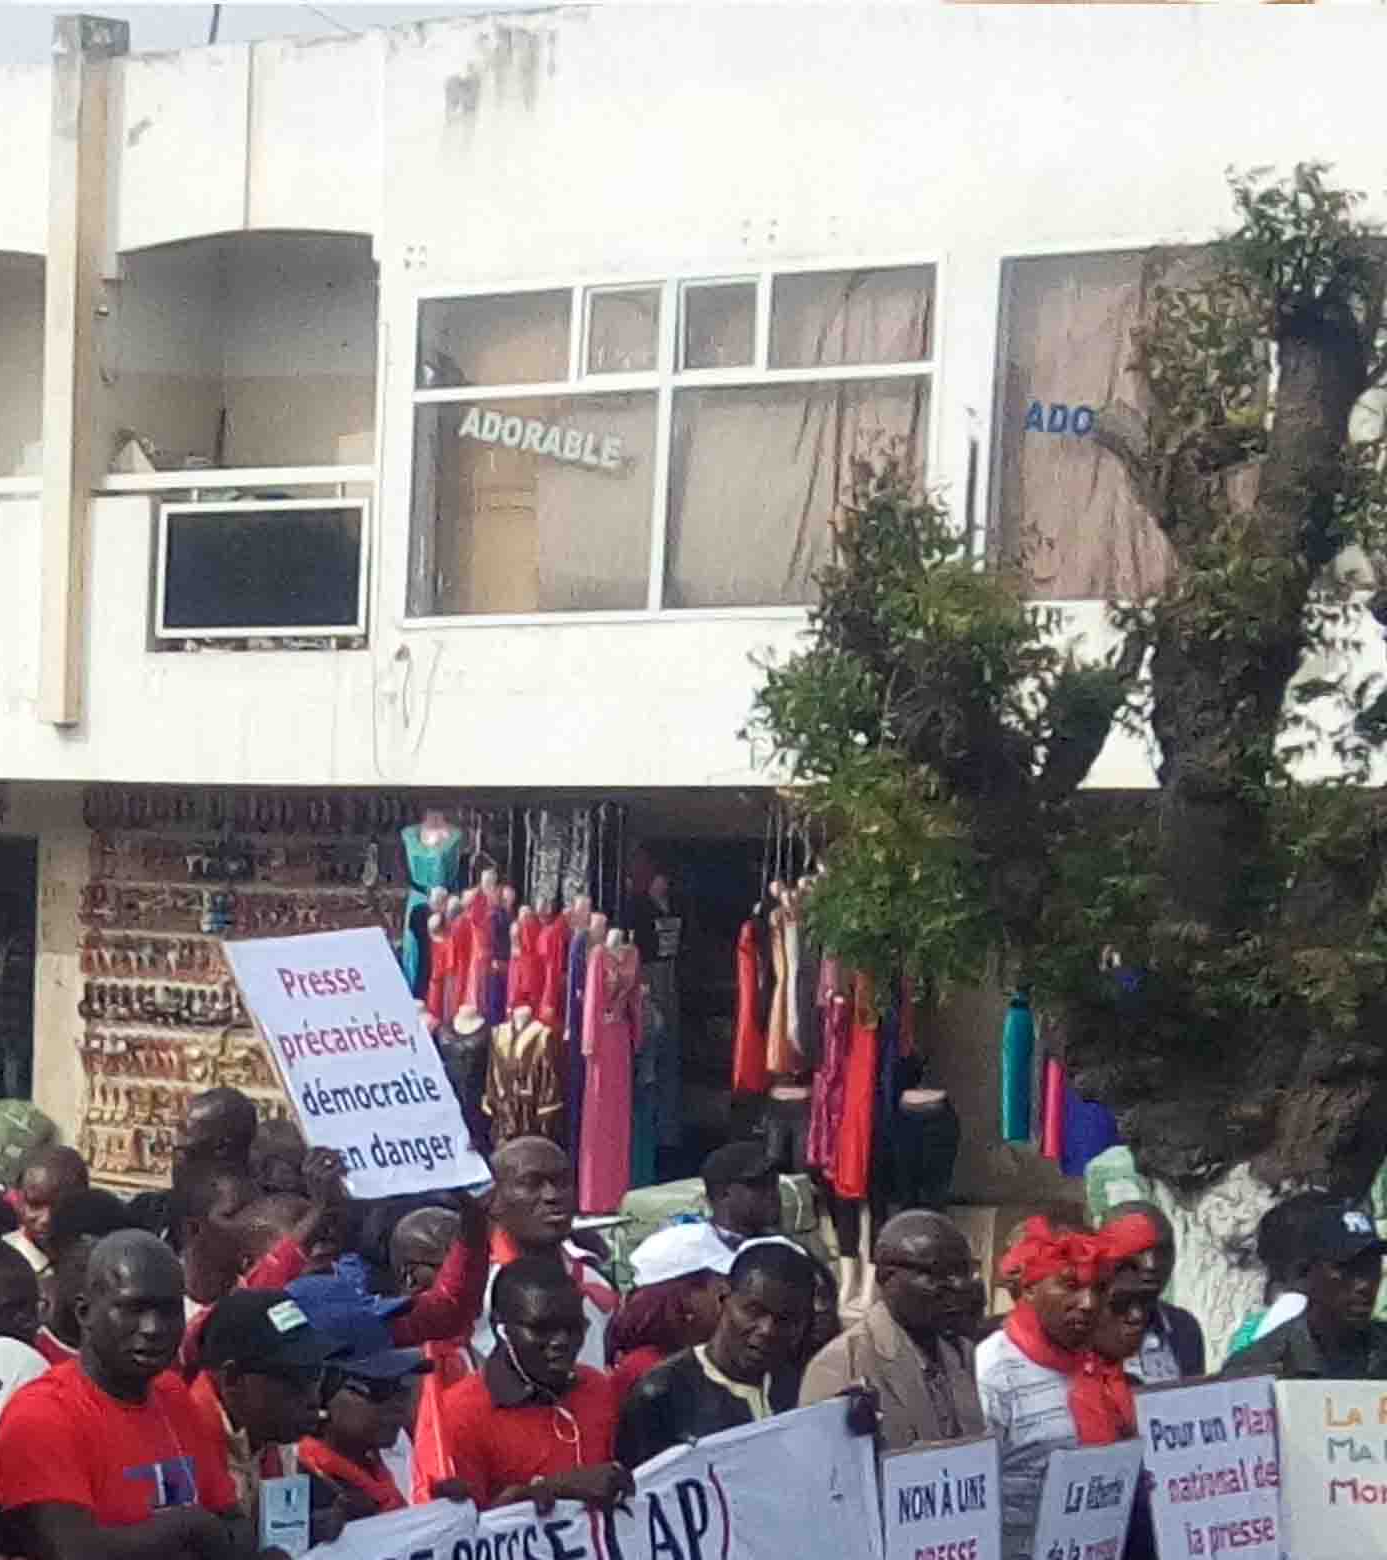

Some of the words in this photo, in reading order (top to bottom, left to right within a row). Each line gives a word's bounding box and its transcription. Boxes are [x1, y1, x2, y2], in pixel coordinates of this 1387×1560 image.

[458, 407, 624, 470] ADORABLE
[277, 966, 366, 1000] Presse
[278, 1010, 418, 1068] précarisée,
[301, 1068, 442, 1118] démocratie
[369, 1131, 455, 1171] danger
[1149, 1416, 1195, 1452] Pour
[1199, 1416, 1228, 1444] un
[898, 1481, 937, 1524] NON
[956, 1473, 987, 1513] UNE
[1166, 1458, 1250, 1504] national
[1183, 1521, 1206, 1556] la
[1208, 1516, 1277, 1559] presse
